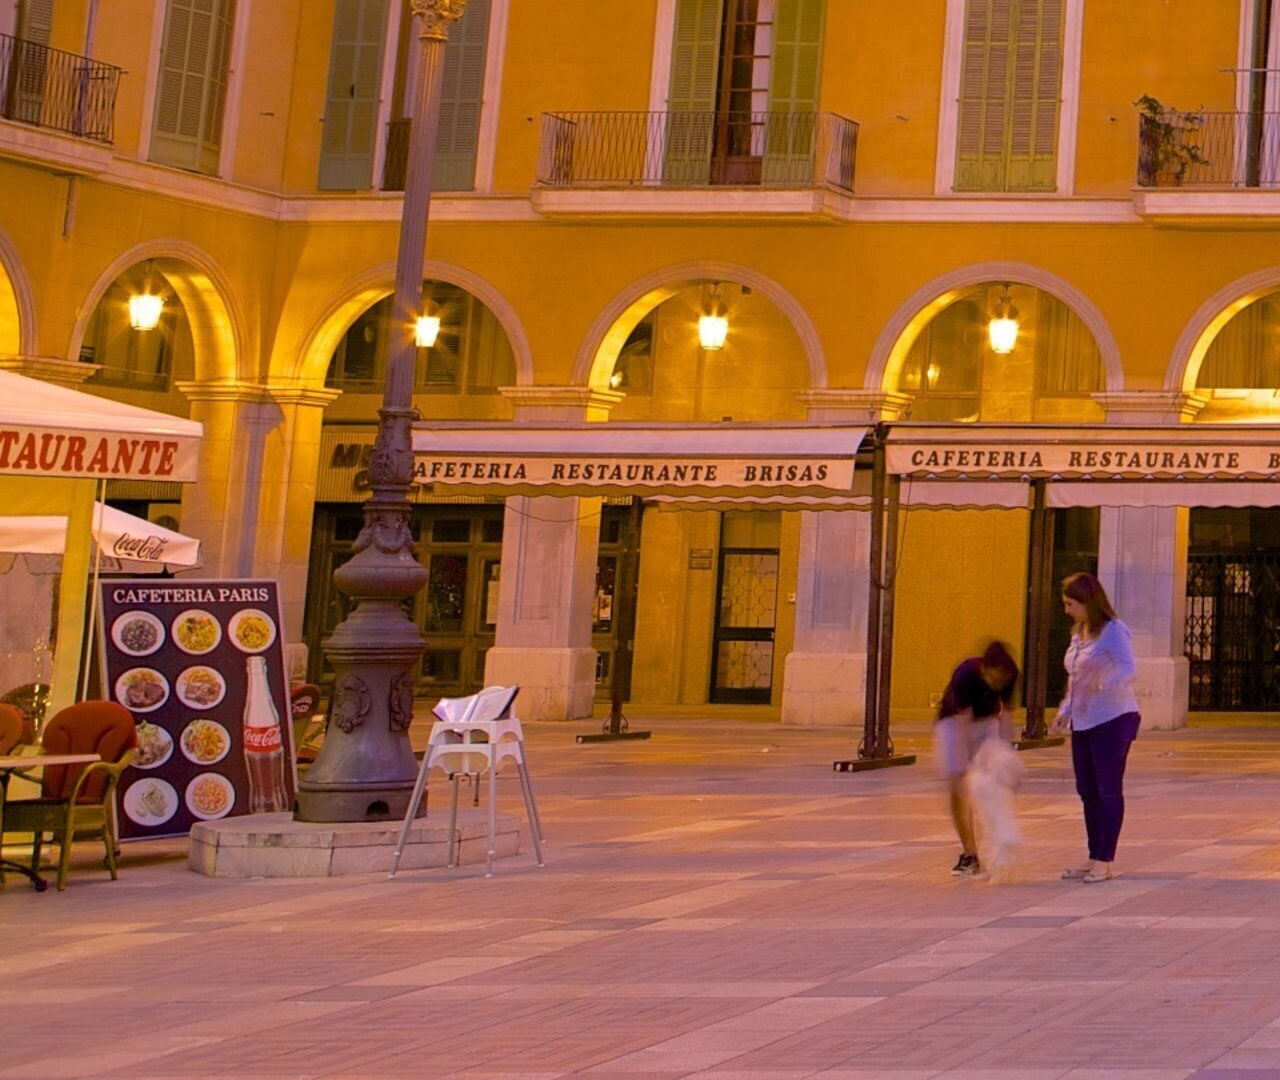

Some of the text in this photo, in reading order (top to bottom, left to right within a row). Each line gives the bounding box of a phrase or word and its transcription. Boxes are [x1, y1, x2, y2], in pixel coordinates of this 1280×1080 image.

[0, 431, 178, 476] TAURANTE
[911, 450, 1043, 467] CAFETERIA
[1068, 451, 1240, 468] RESTAURANTE
[412, 462, 828, 482] AFETERIA RESTAURANTE BRISAS
[113, 587, 269, 604] CAFETERIA PARIS
